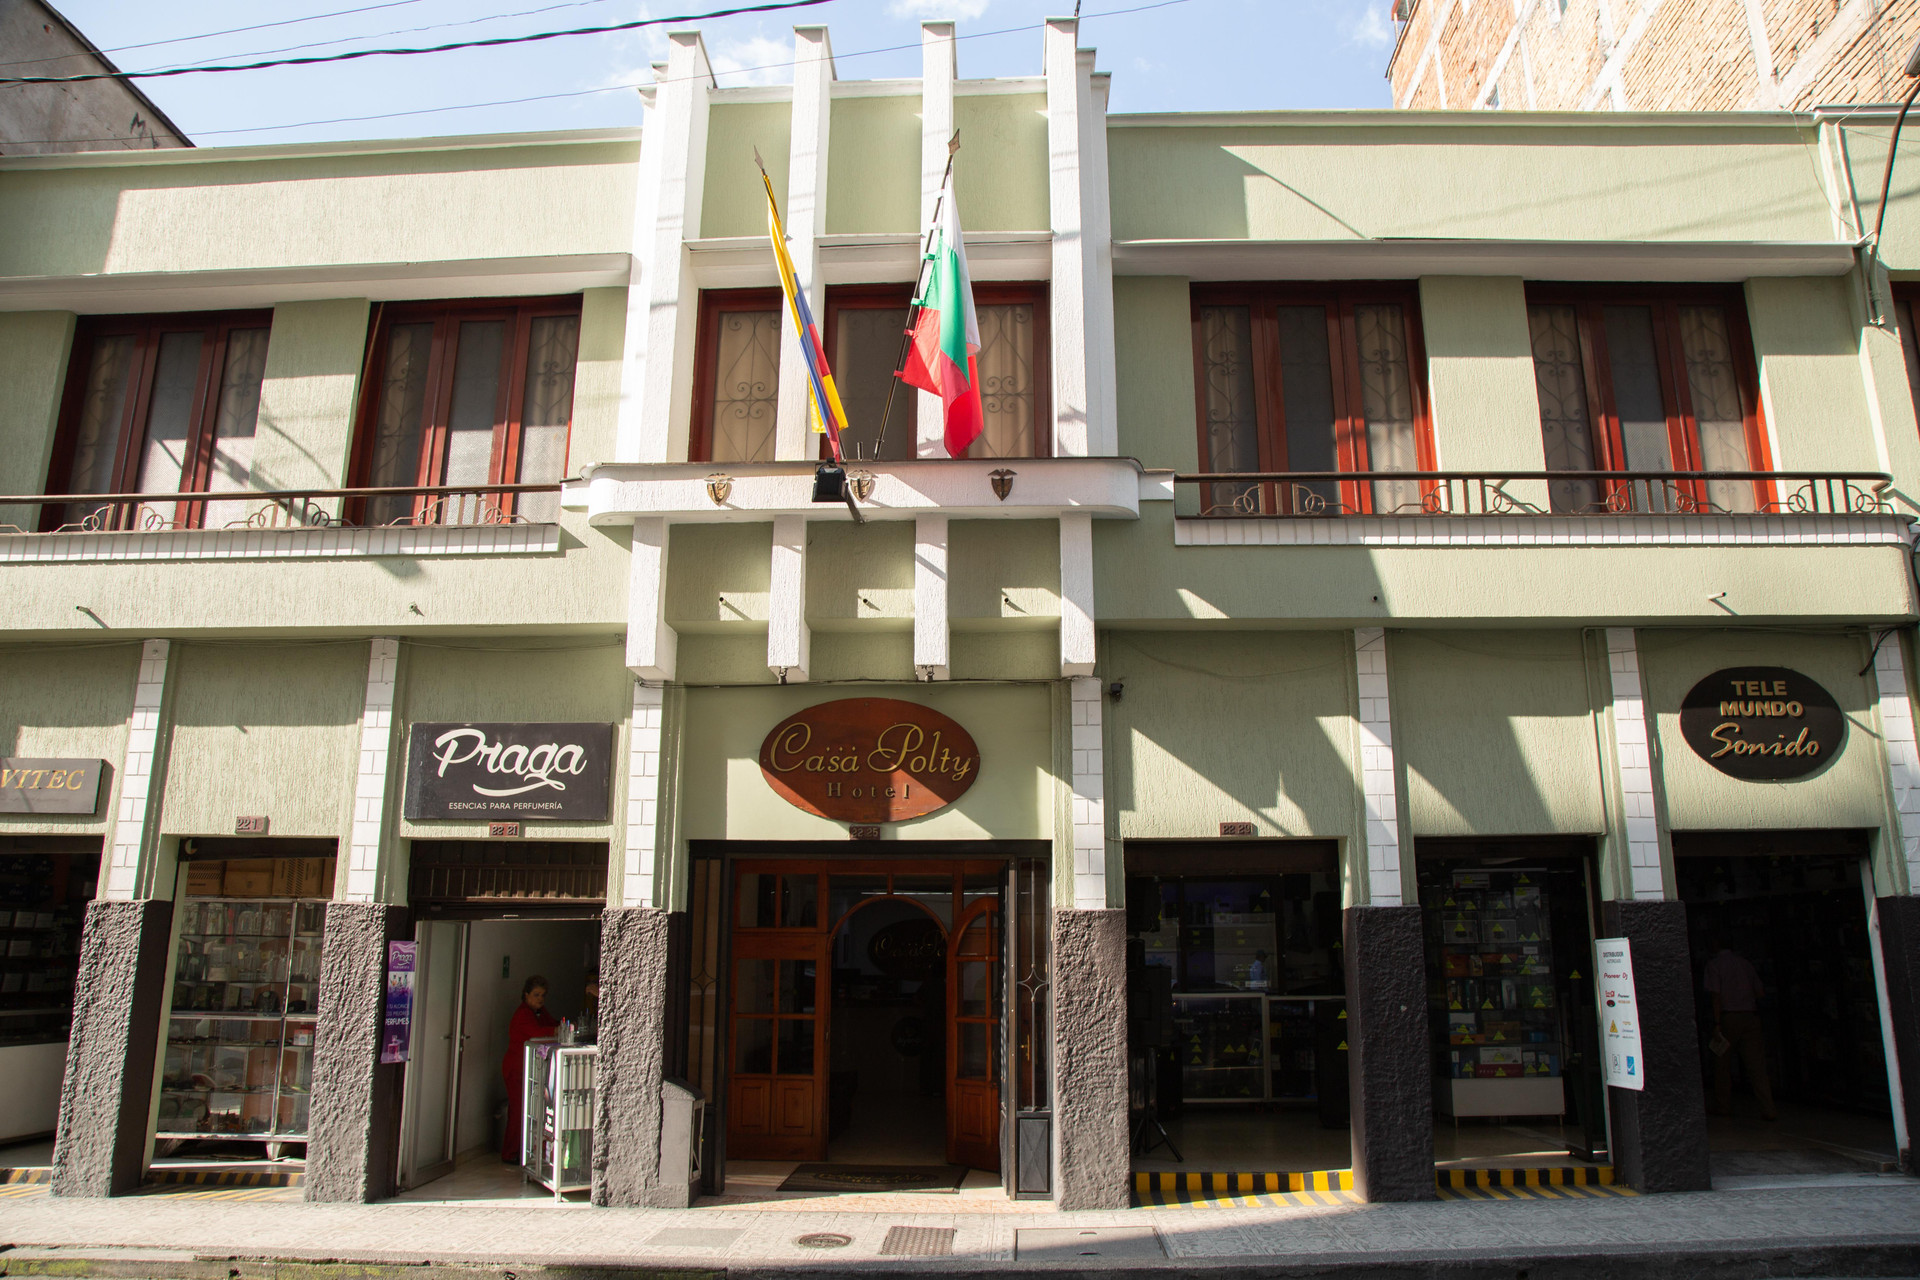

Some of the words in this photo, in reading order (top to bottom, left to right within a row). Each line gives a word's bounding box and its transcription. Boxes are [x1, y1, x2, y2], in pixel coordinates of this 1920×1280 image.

[1731, 680, 1788, 696] TELE
[1719, 701, 1804, 717] MUNDO
[1710, 721, 1820, 758] Sonido
[770, 722, 860, 772] Casa
[867, 723, 972, 781] Polty
[432, 728, 588, 797] Praga
[0, 769, 86, 791] VITEC
[827, 783, 910, 799] Hotel
[448, 802, 487, 810] ESENCIAS
[490, 802, 511, 810] PARA
[513, 801, 563, 810] PERFUMERÍA
[491, 825, 504, 836] 22
[507, 825, 518, 836] 21
